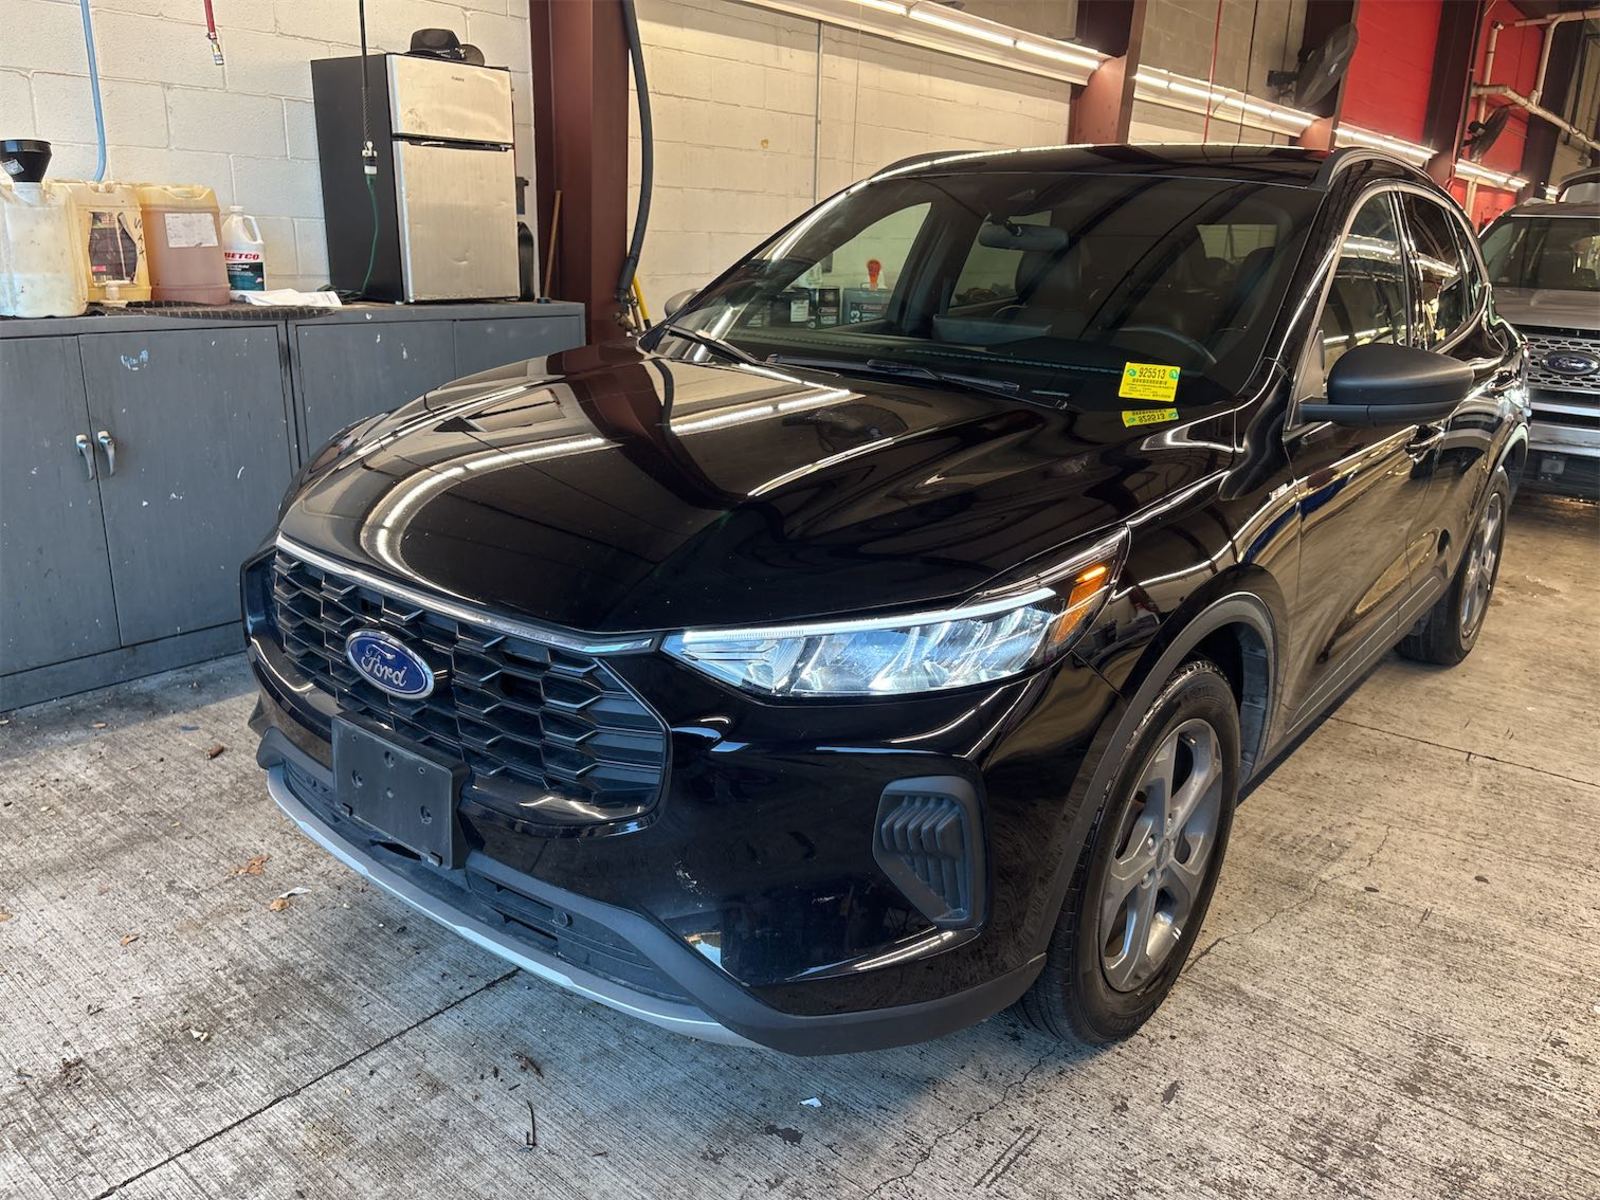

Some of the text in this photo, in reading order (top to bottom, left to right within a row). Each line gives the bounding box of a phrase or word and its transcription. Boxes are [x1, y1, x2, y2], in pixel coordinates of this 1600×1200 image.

[224, 252, 260, 260] BETCO
[1138, 367, 1166, 380] 925513
[361, 643, 408, 687] Ford
